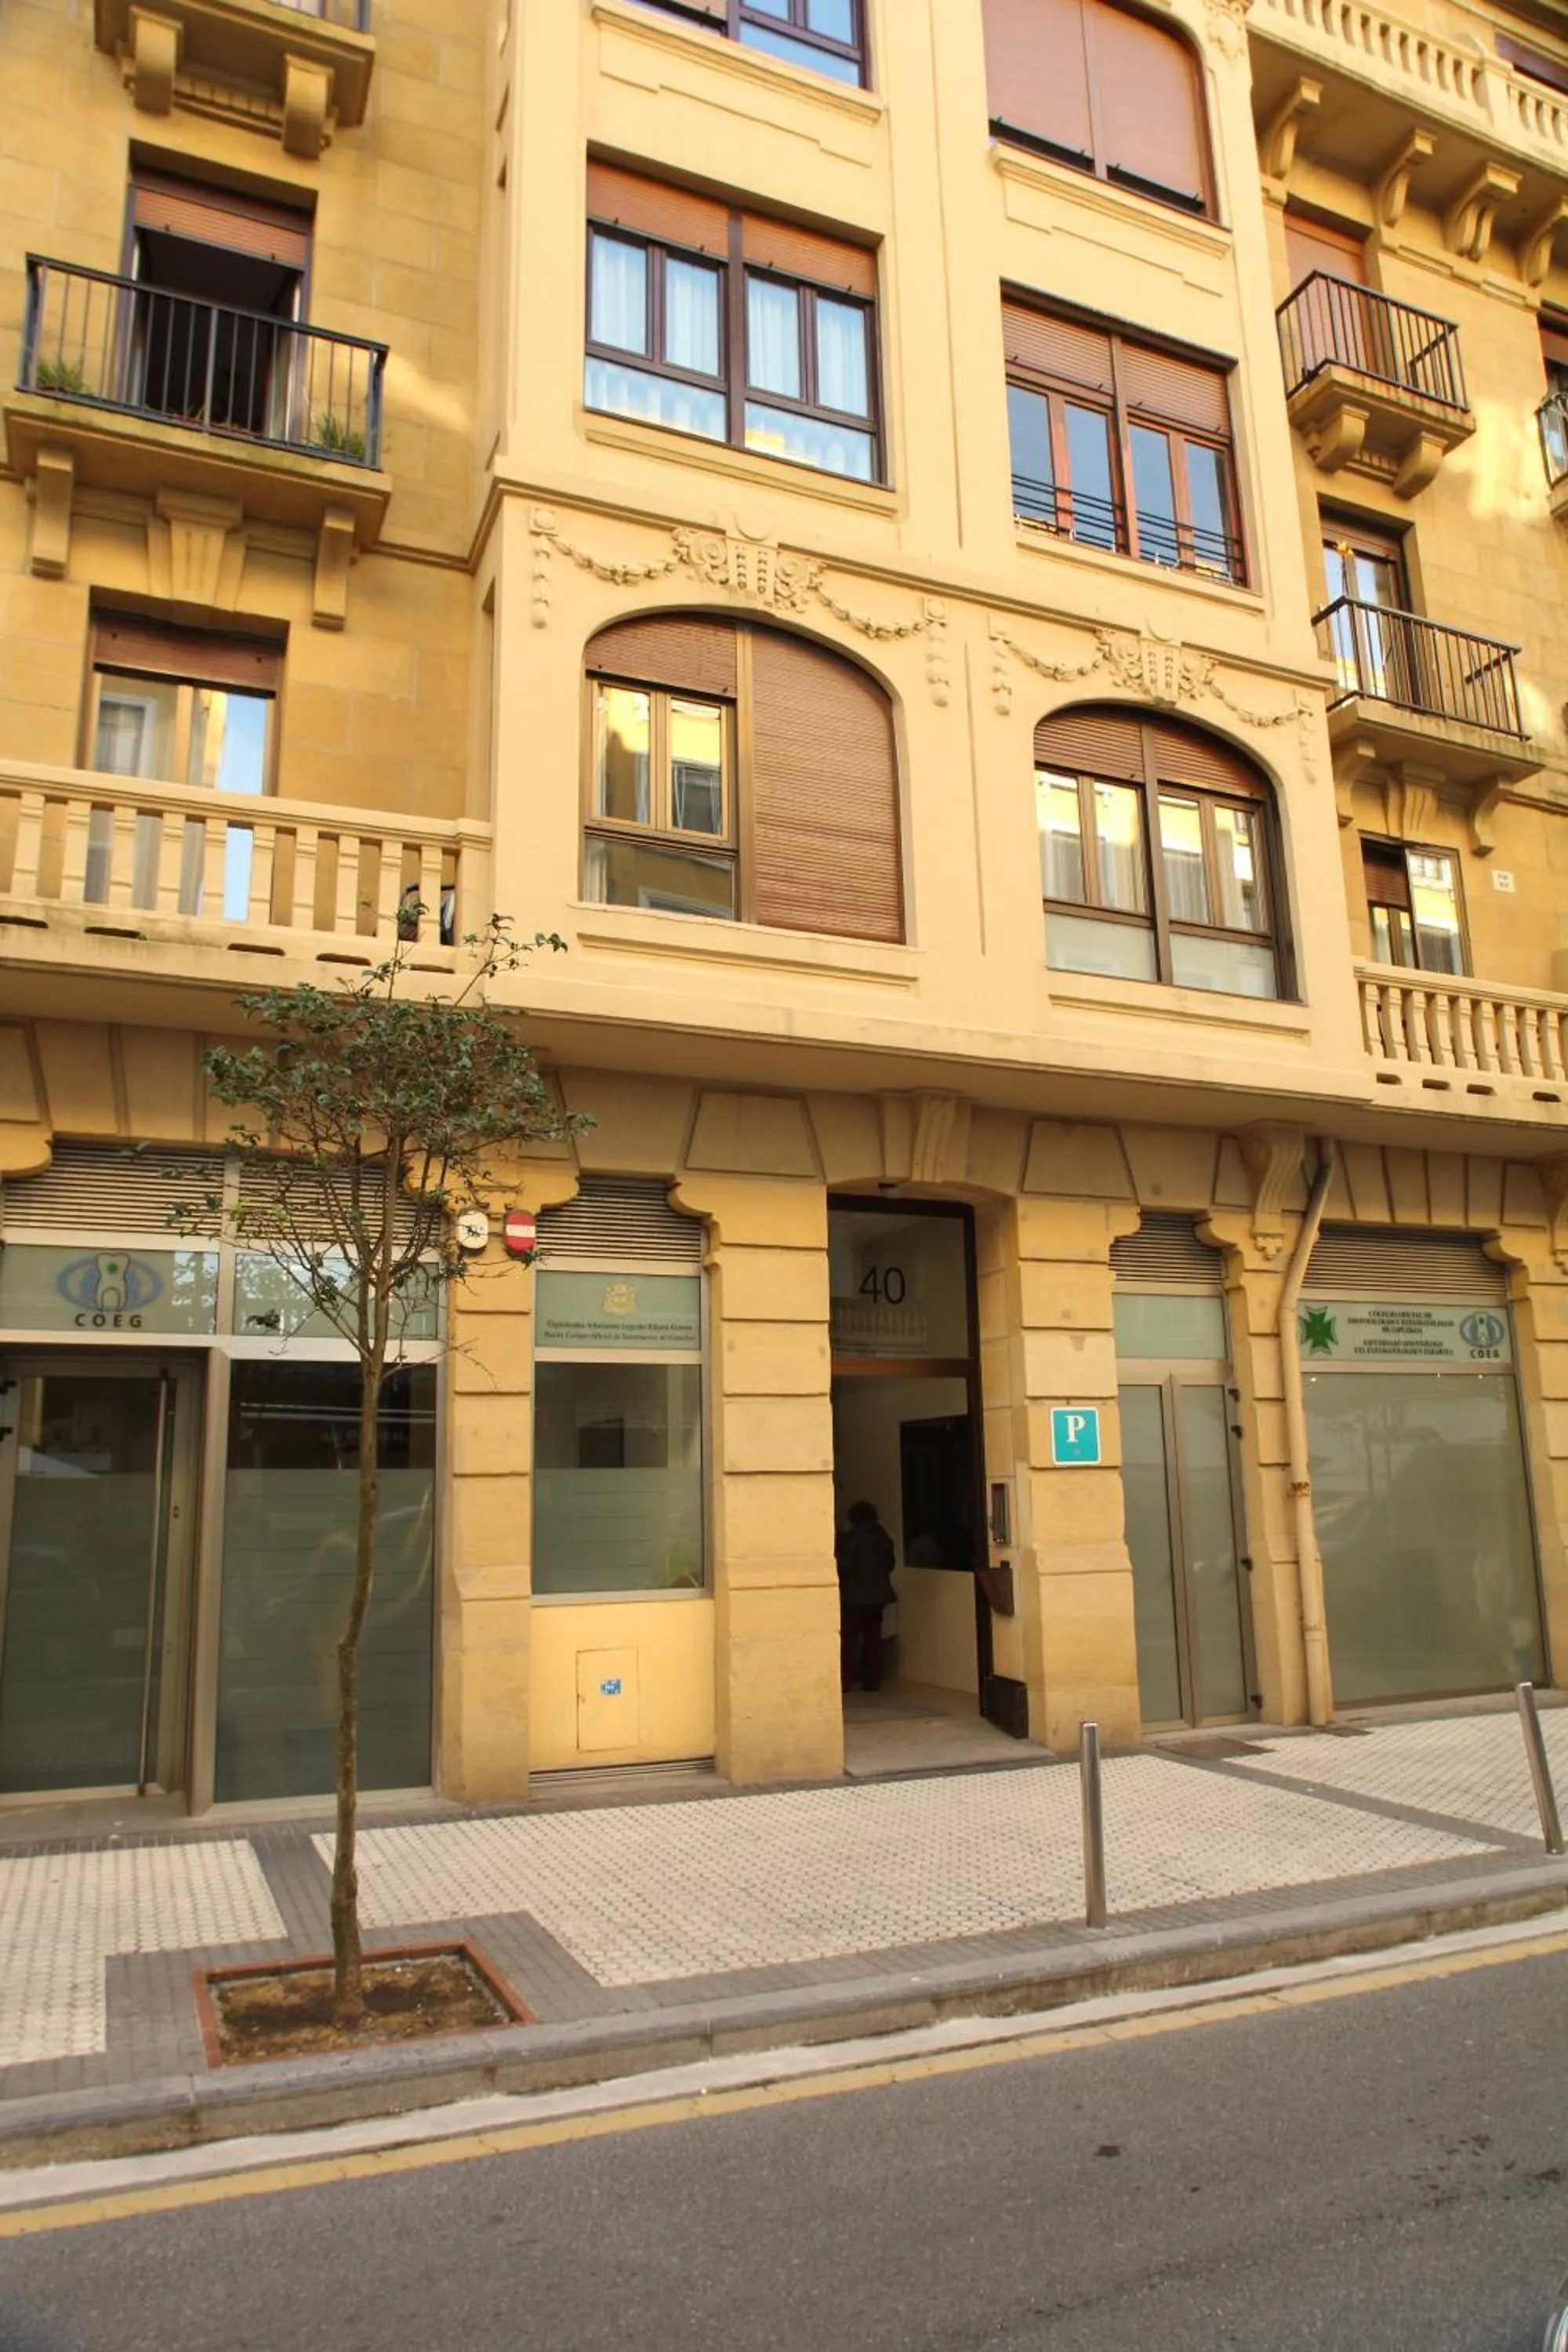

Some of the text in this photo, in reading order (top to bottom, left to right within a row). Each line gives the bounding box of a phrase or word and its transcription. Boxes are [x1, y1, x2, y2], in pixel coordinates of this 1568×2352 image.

[858, 1265, 906, 1305] 40
[74, 1313, 142, 1328] COEG
[1065, 1415, 1085, 1443] P
